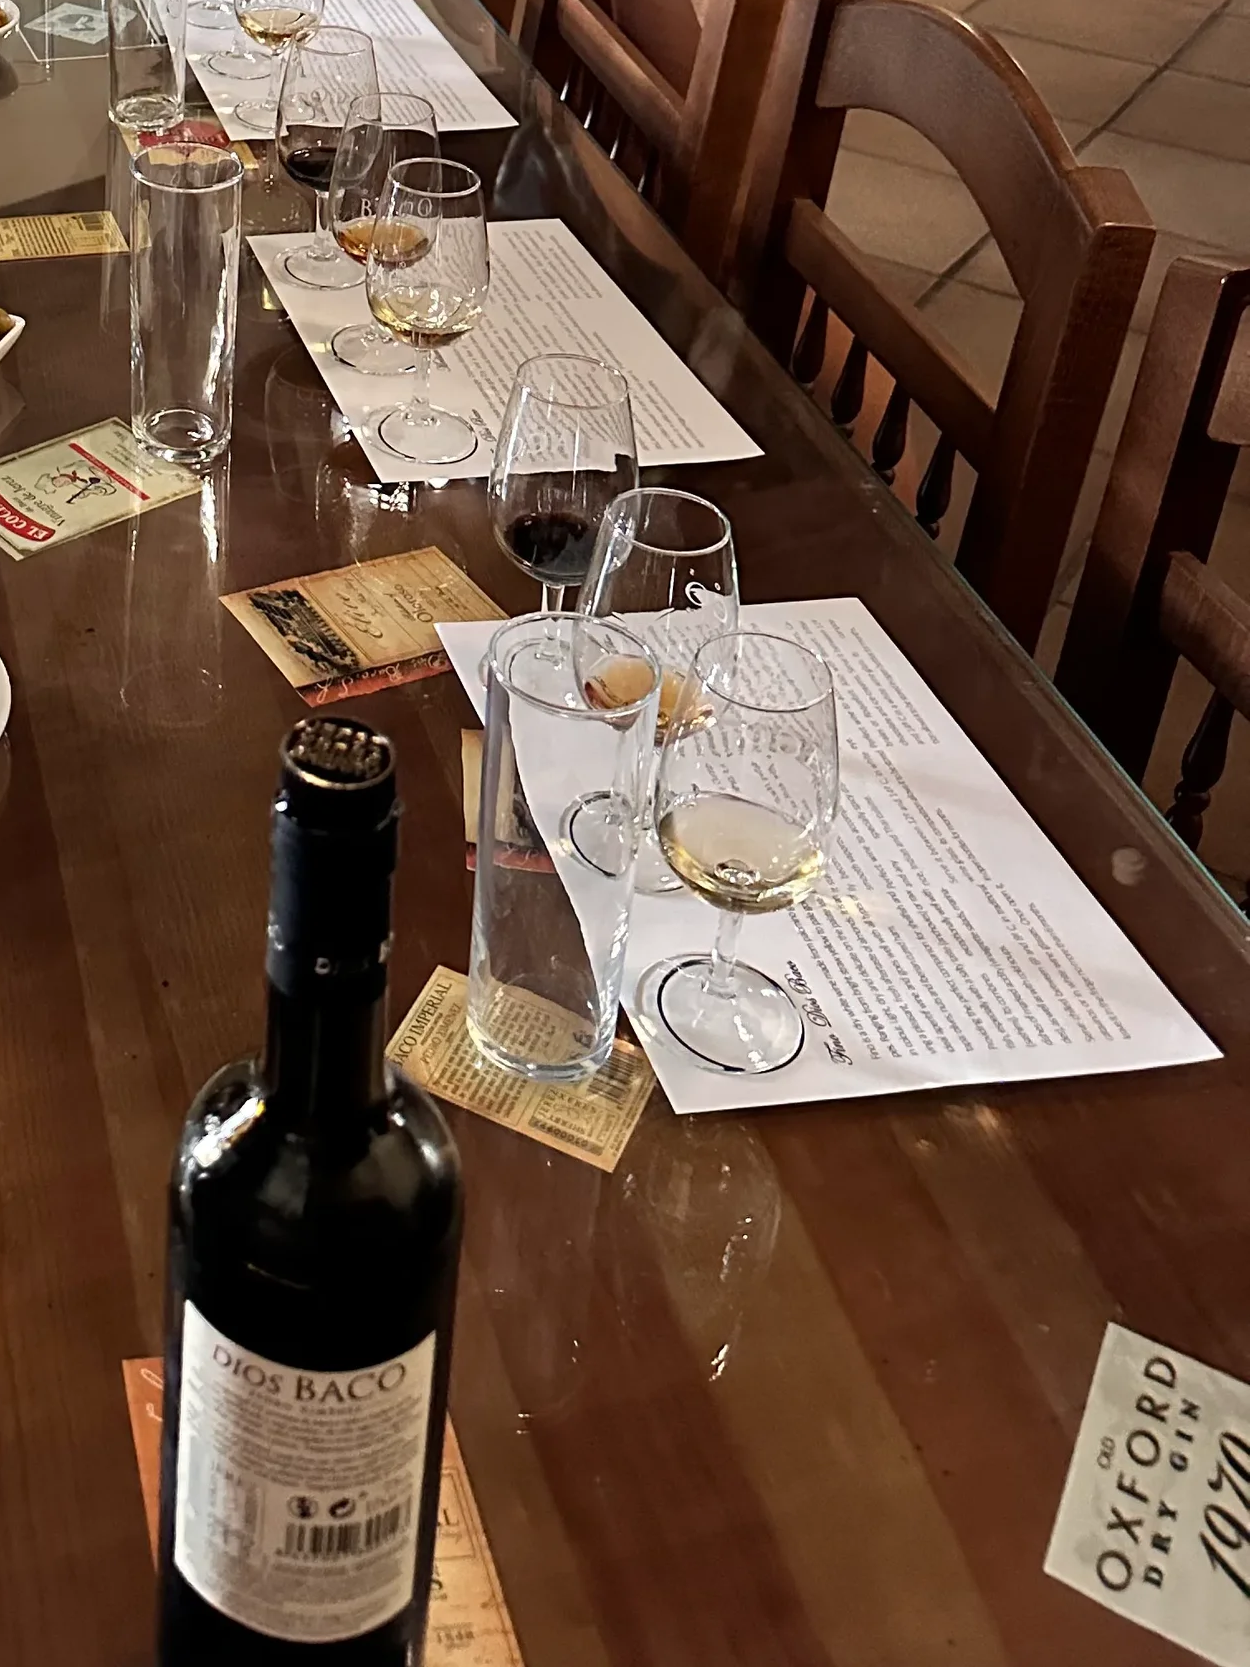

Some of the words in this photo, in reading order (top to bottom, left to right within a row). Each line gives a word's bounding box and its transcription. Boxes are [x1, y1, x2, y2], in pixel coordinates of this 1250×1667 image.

[29, 522, 49, 540] EL
[785, 960, 814, 995] Baco
[408, 982, 453, 1036] IMPERIAL
[829, 1033, 854, 1067] Fino
[212, 1343, 284, 1396] DIOS
[293, 1361, 408, 1404] BACO
[1095, 1355, 1178, 1592] OXFORD
[1142, 1499, 1179, 1590] DRY
[1168, 1397, 1201, 1473] GIN
